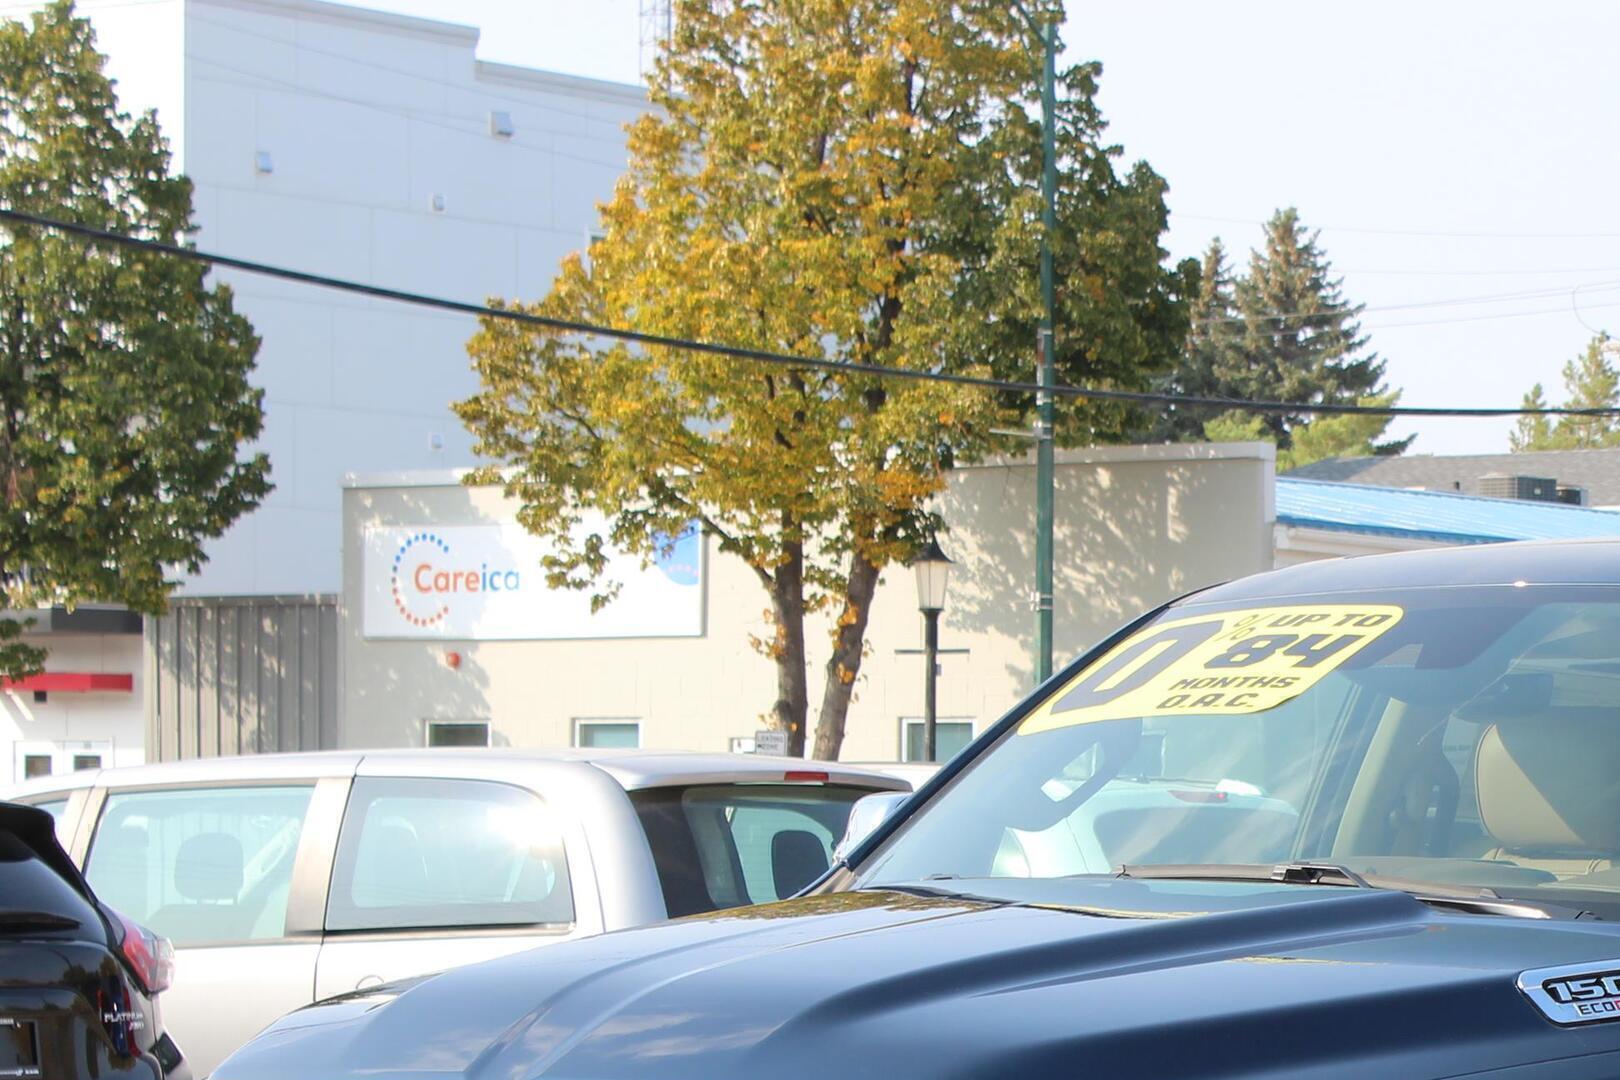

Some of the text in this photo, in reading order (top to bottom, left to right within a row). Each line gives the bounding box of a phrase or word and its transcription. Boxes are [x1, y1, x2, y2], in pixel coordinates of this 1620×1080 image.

[414, 564, 519, 593] Careica
[1267, 613, 1391, 627] UP TO
[1204, 634, 1364, 669] 84
[1168, 676, 1301, 691] MONTHS
[1156, 693, 1255, 709] O.A.C.
